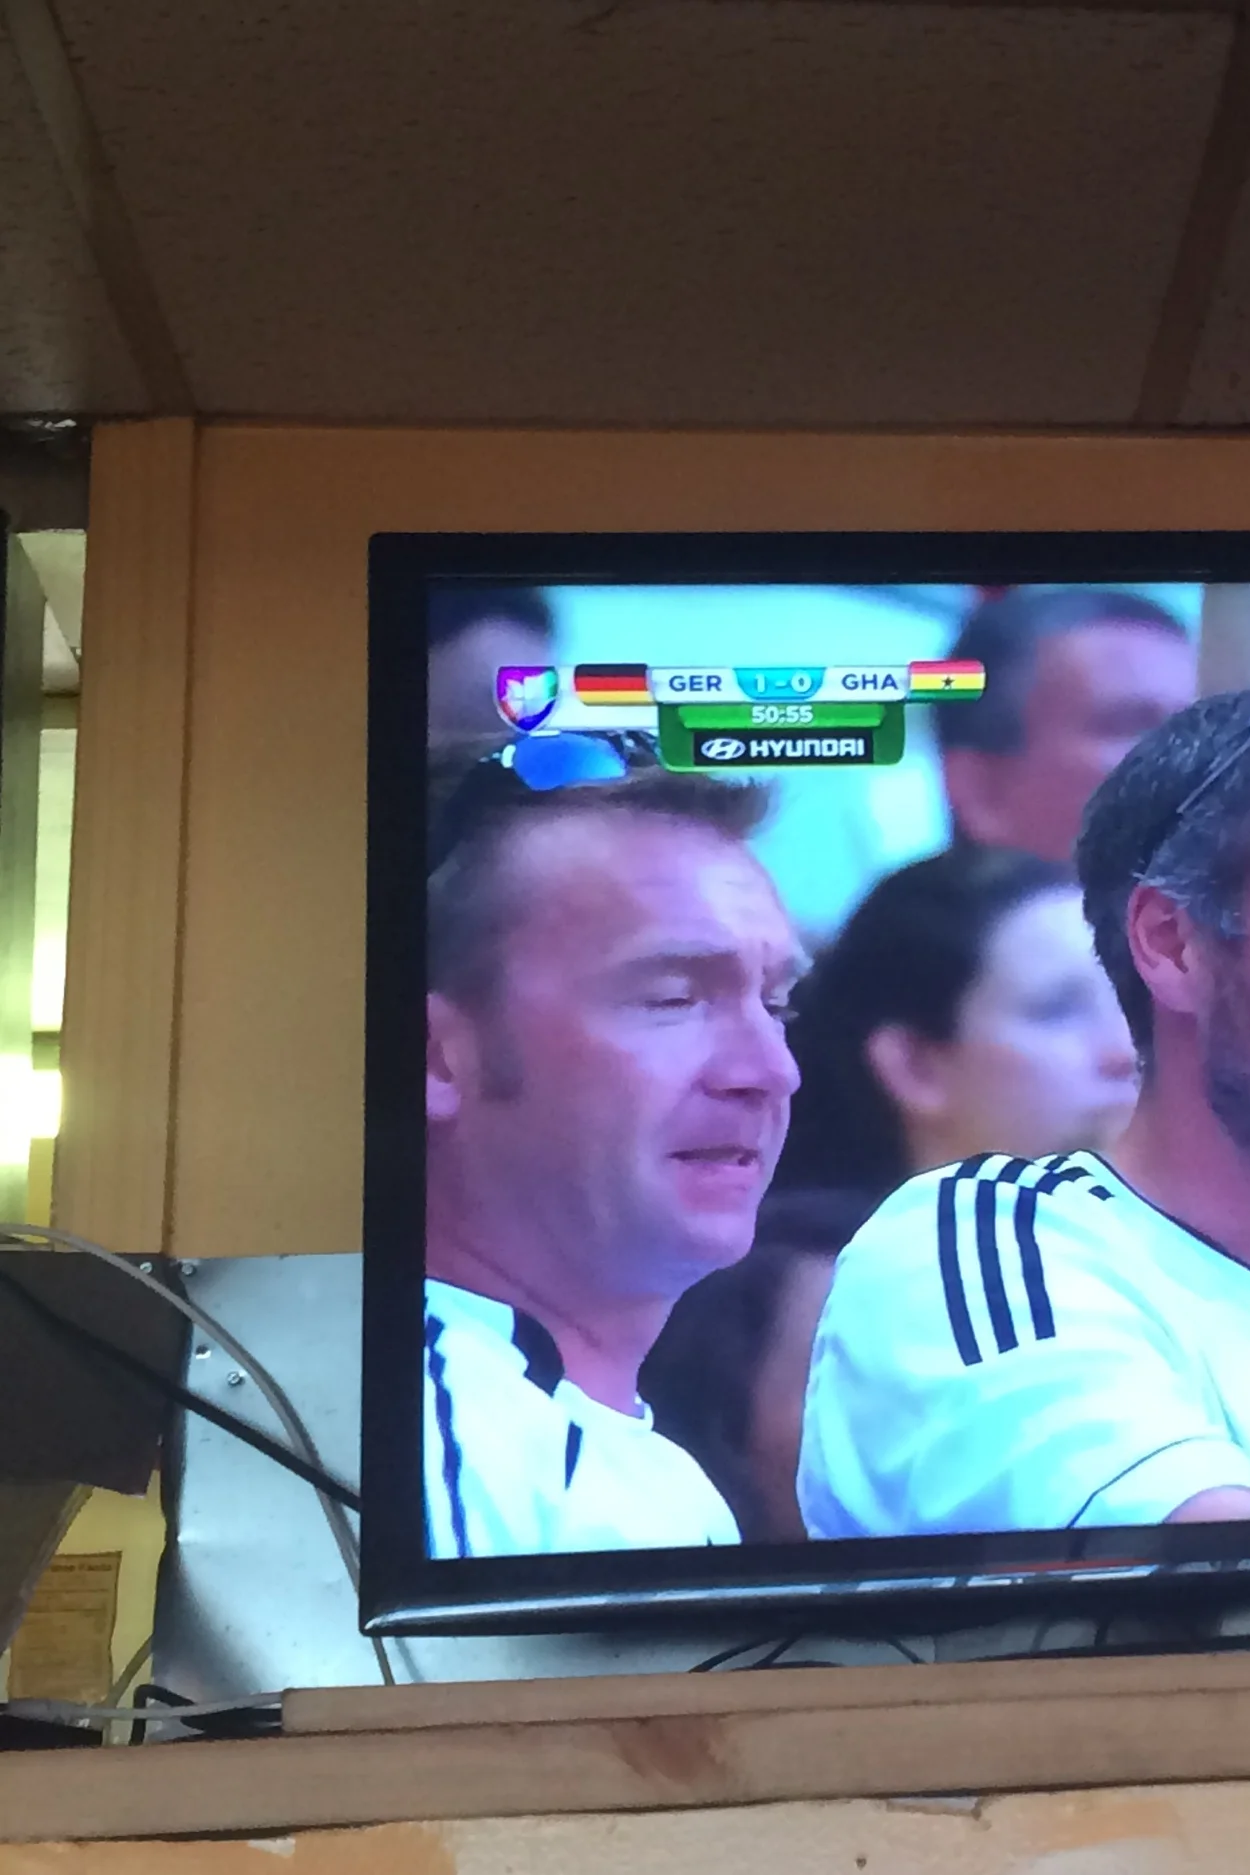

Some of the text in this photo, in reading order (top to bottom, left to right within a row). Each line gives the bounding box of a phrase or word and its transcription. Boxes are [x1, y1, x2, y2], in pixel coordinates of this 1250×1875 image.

[668, 674, 722, 692] GER
[841, 673, 899, 691] GHA
[751, 705, 813, 724] 50:55
[750, 738, 865, 758] HYUNDAI
